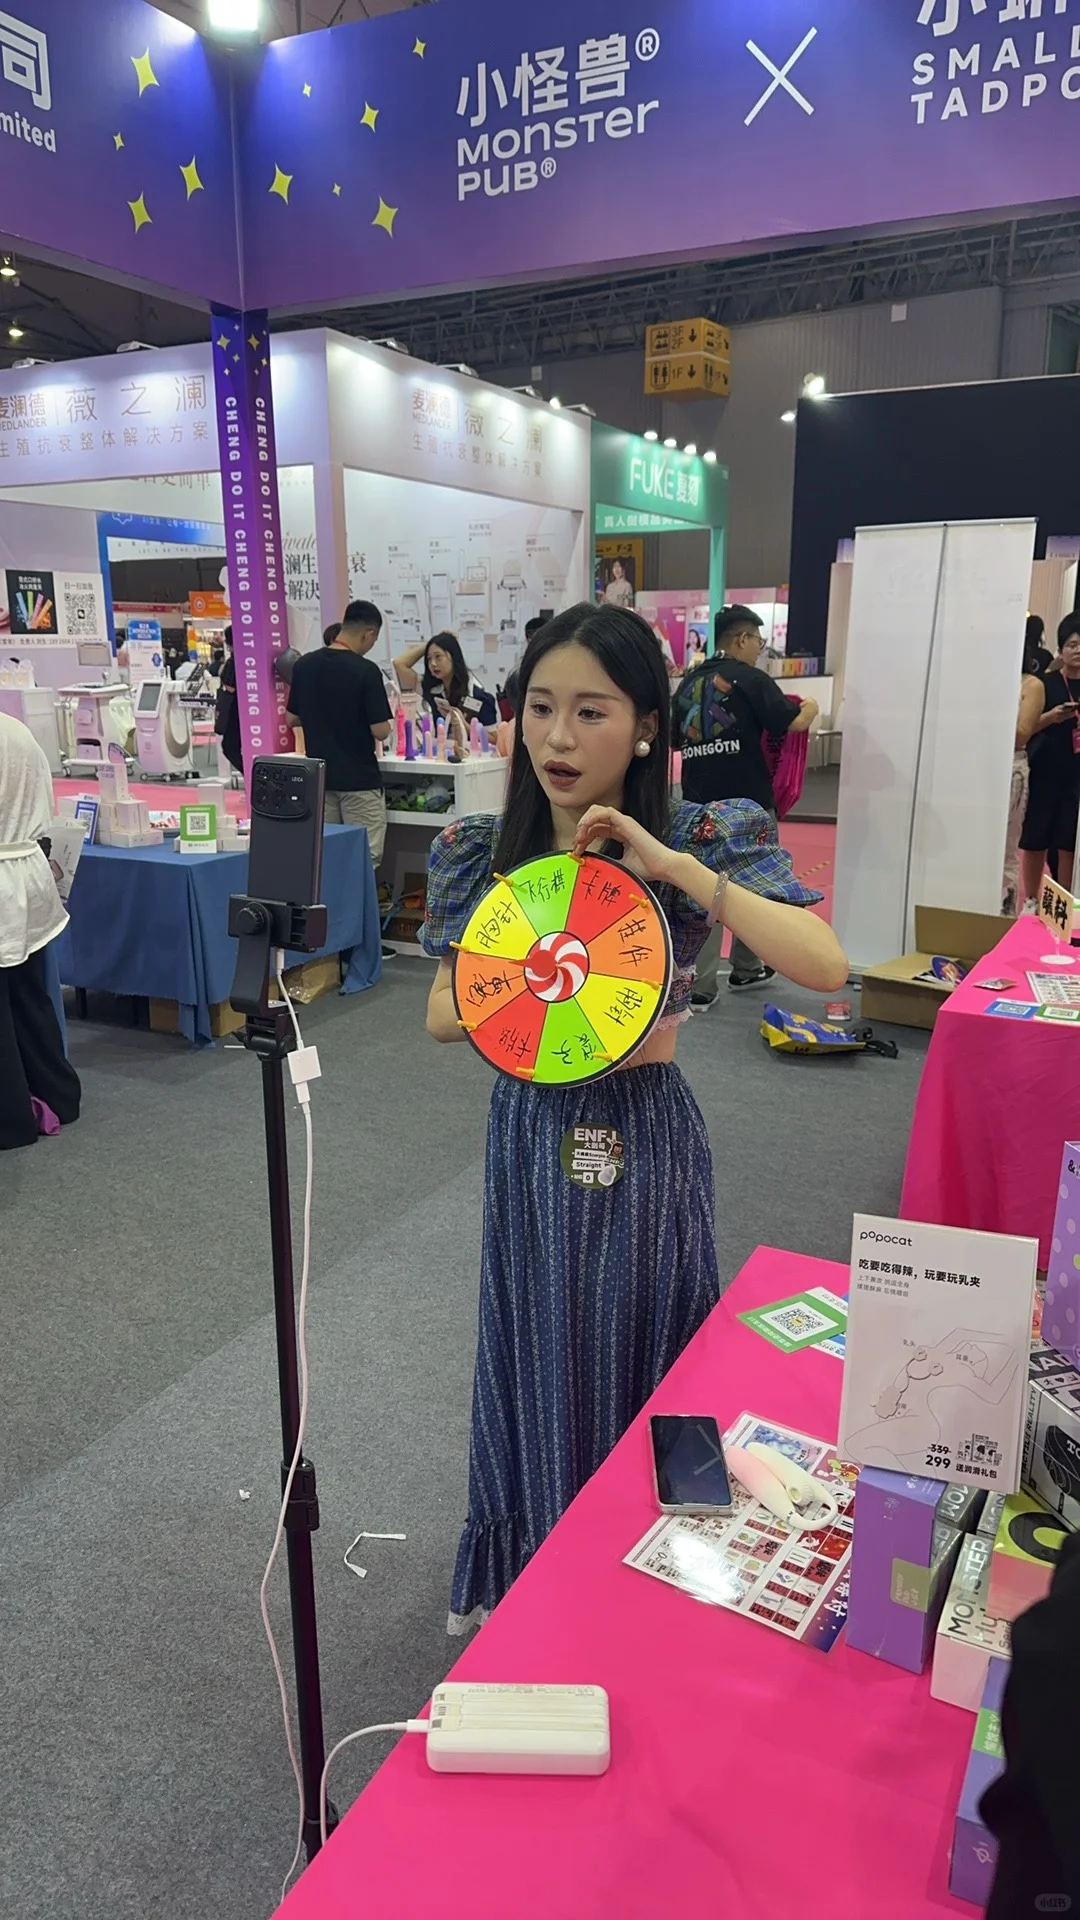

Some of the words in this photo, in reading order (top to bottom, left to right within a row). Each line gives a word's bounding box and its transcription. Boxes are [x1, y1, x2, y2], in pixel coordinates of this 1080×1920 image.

[672, 338, 684, 350] 2F
[672, 367, 683, 379] 1F
[225, 397, 241, 461] CHENG
[255, 397, 268, 461] CHENG
[230, 471, 243, 495] DO
[260, 472, 271, 496] DO
[233, 503, 245, 520] IT
[262, 504, 273, 520] IT
[234, 529, 250, 591] CHENG
[264, 529, 277, 591] CHENG
[240, 601, 253, 625] DO
[269, 601, 280, 625] DO
[242, 632, 255, 648] IT
[272, 632, 281, 648] IT
[244, 657, 260, 716] CHENG
[250, 725, 262, 747] DO
[279, 724, 288, 747] DO
[860, 1231, 913, 1247] popocat
[925, 1454, 951, 1469] 299
[956, 1464, 998, 1479] 送润滑礼包
